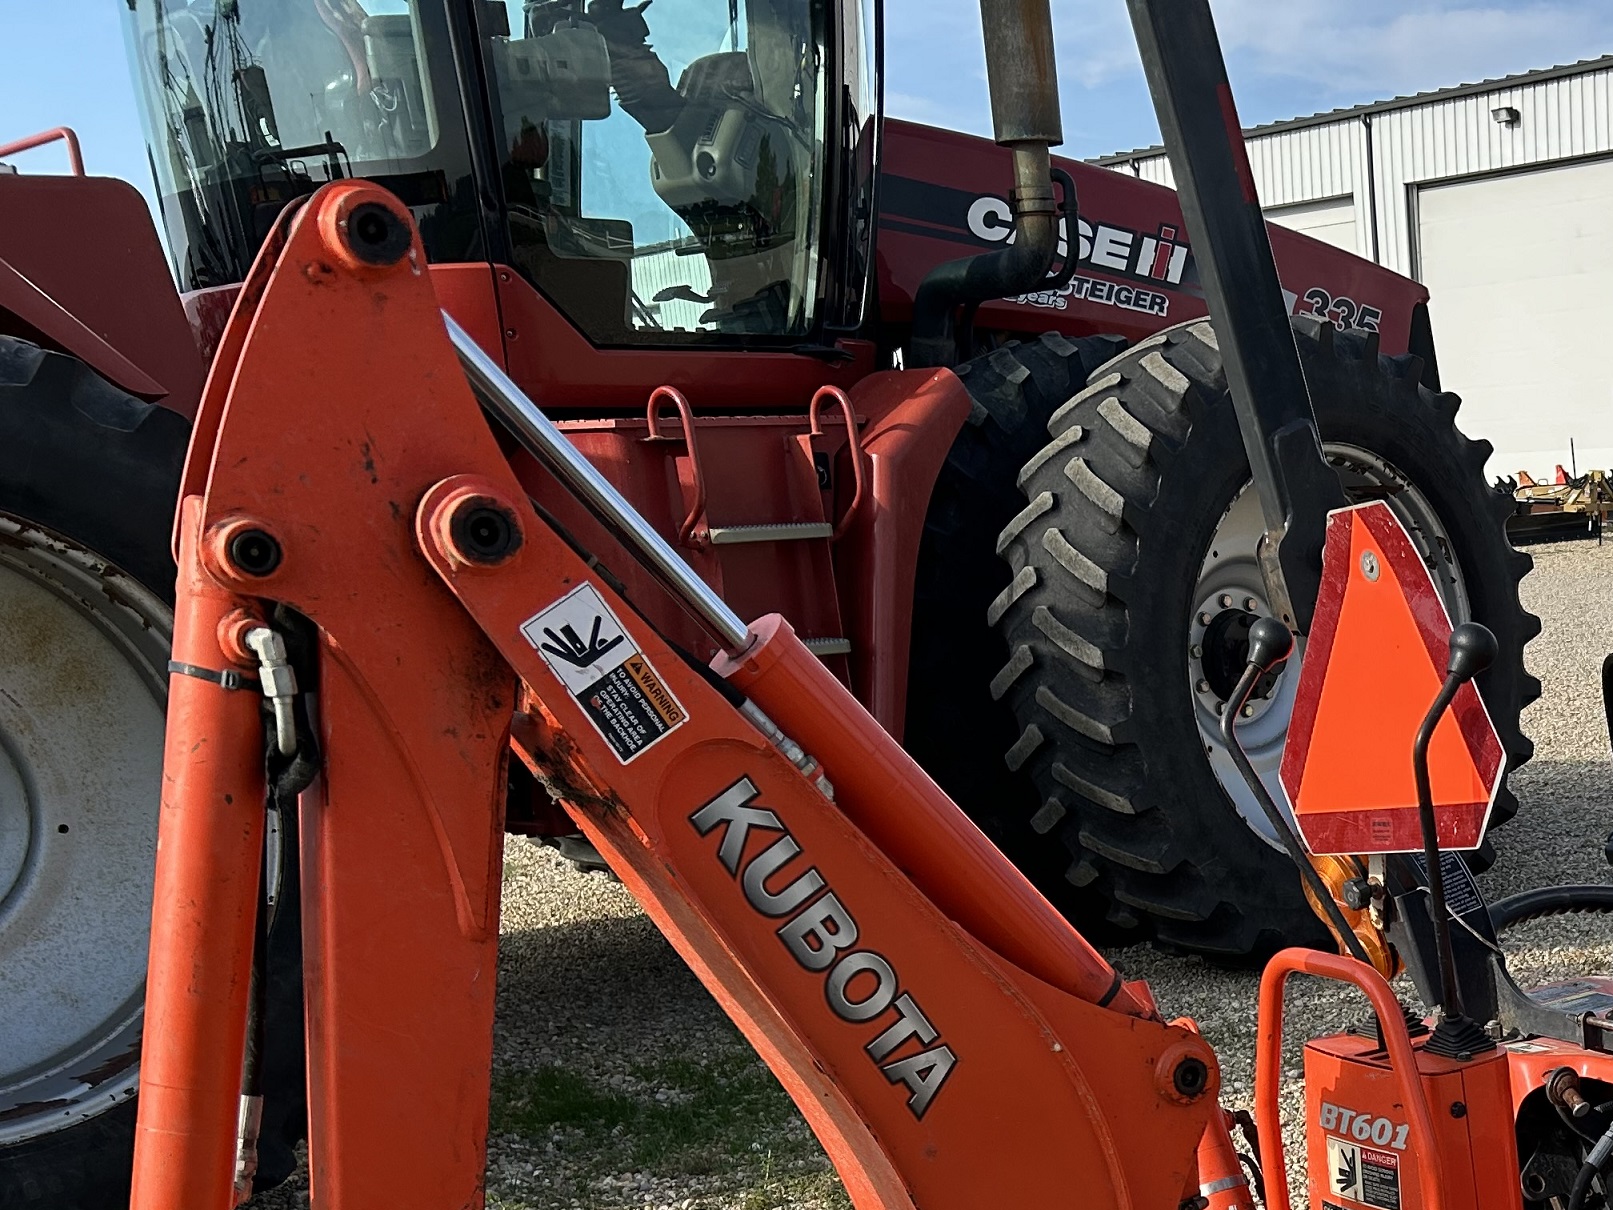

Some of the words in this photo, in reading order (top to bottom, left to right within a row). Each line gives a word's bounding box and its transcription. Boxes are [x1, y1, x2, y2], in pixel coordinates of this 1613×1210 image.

[967, 196, 1134, 272] CSE
[1300, 287, 1382, 331] 335
[599, 689, 630, 728] OPERATING
[627, 726, 643, 746] AREA
[600, 704, 614, 720] THE
[606, 684, 623, 703] STAY
[619, 702, 639, 726] CLEAR
[636, 724, 647, 735] OF
[616, 667, 626, 679] TO
[624, 676, 642, 699] AVOID
[638, 698, 666, 733] PERSONAL
[641, 671, 679, 722] WARNING
[688, 773, 959, 1122] KUBOTA
[1319, 1102, 1410, 1151] BT601
[1367, 1152, 1397, 1167] DANGER
